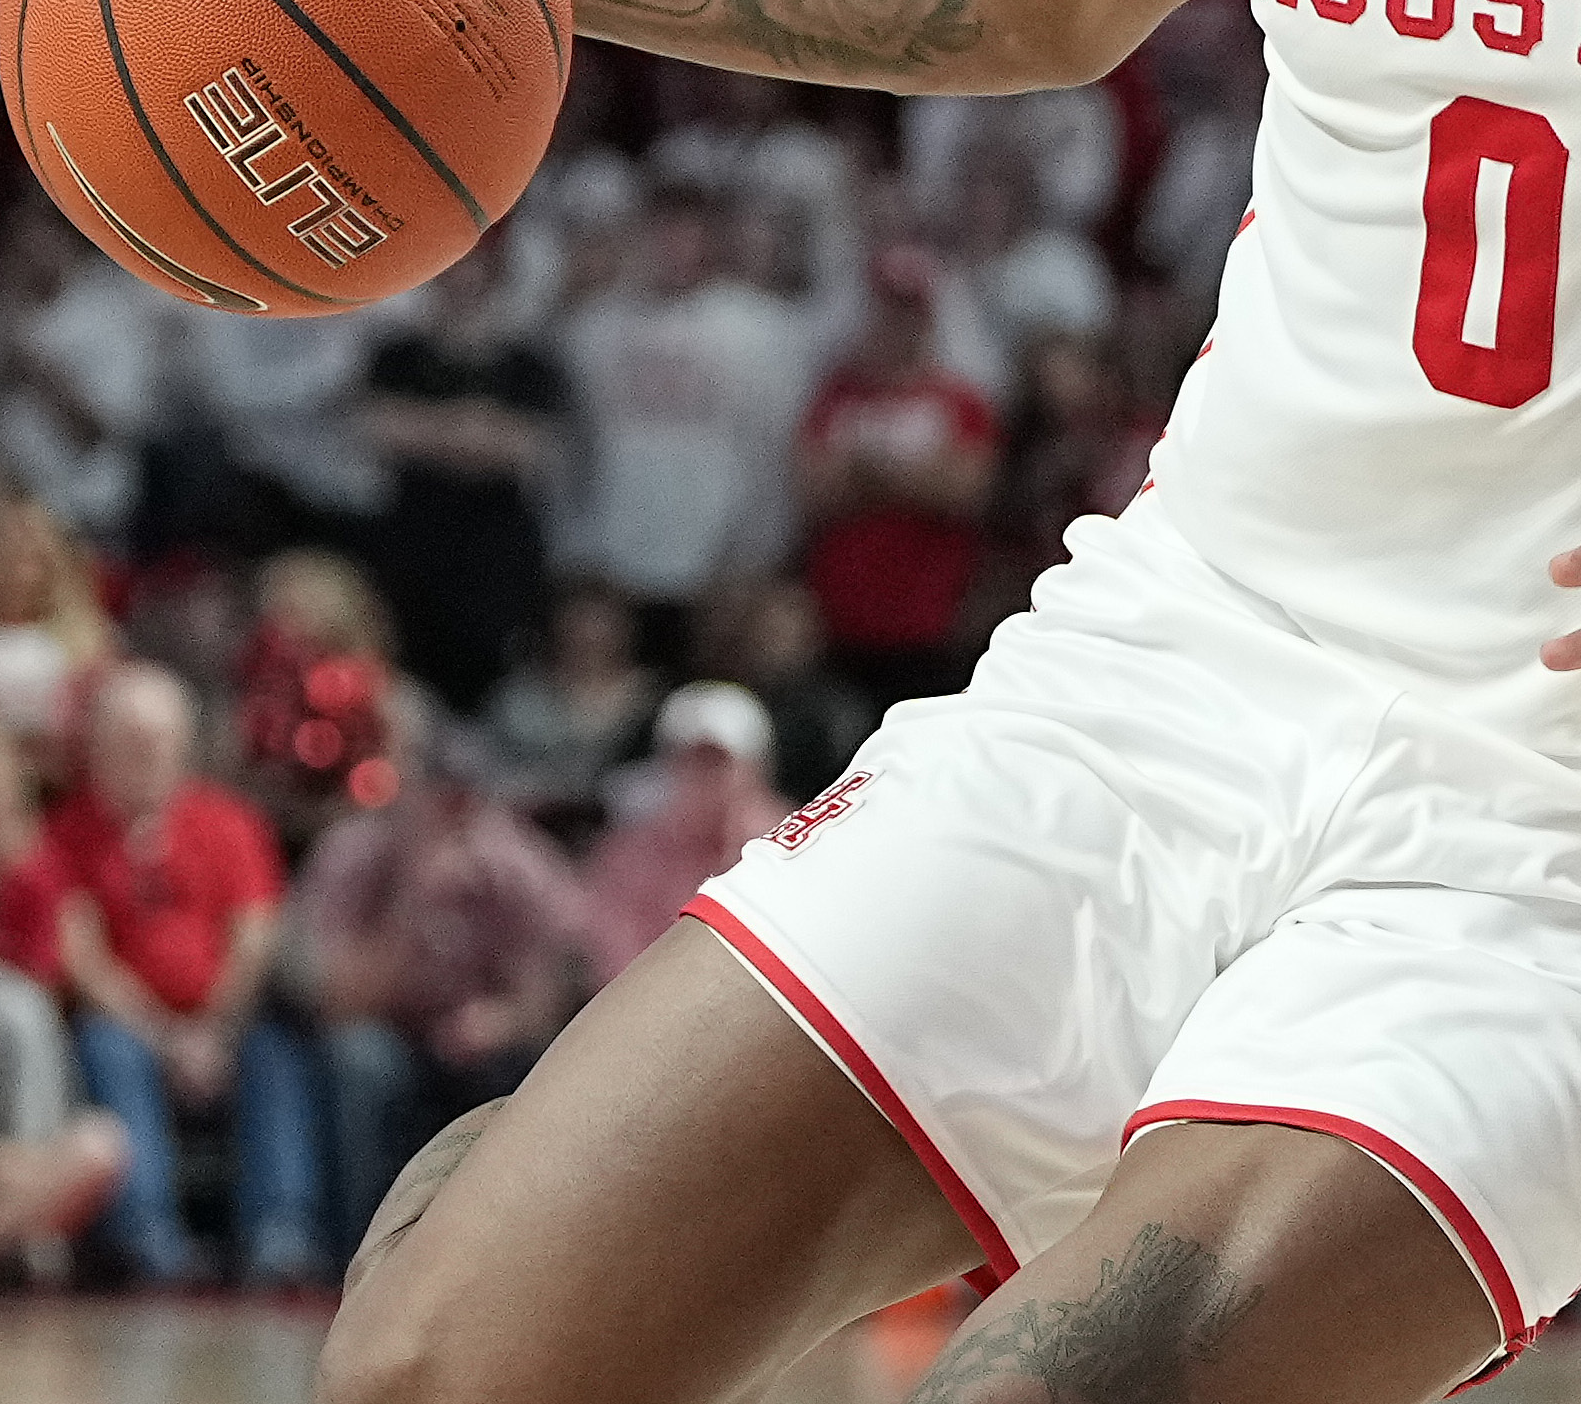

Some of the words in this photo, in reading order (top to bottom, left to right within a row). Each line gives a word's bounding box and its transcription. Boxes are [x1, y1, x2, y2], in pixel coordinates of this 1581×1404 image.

[182, 67, 388, 271] ELITE
[241, 56, 406, 235] CHAMPIONSHIP
[1411, 95, 1569, 410] 0
